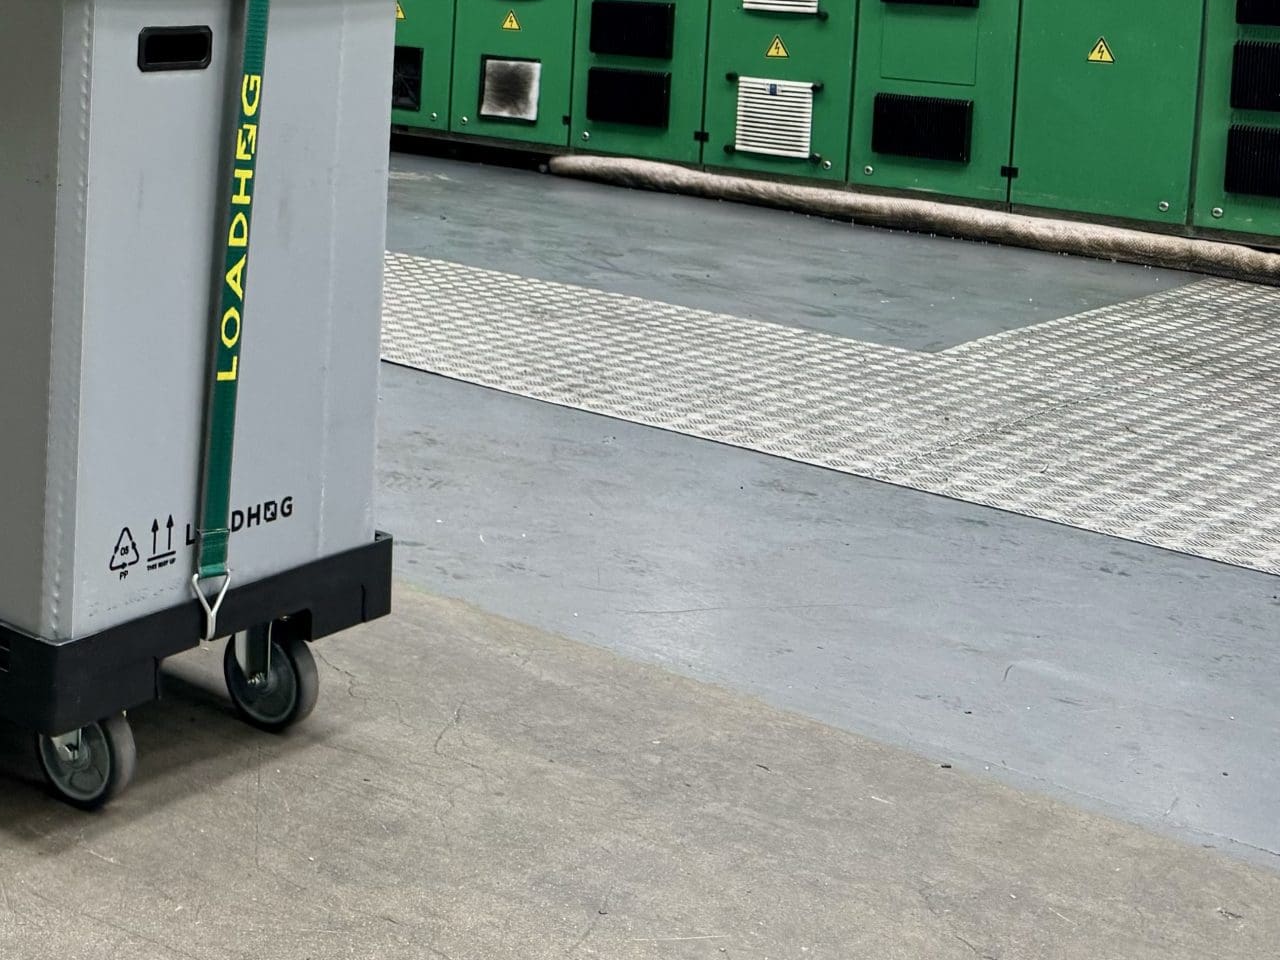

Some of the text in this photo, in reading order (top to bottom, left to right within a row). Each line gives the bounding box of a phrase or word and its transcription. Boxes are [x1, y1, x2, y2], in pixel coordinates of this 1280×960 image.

[217, 74, 261, 381] LOADHOG
[186, 496, 293, 545] LDHOG
[119, 570, 129, 580] PP
